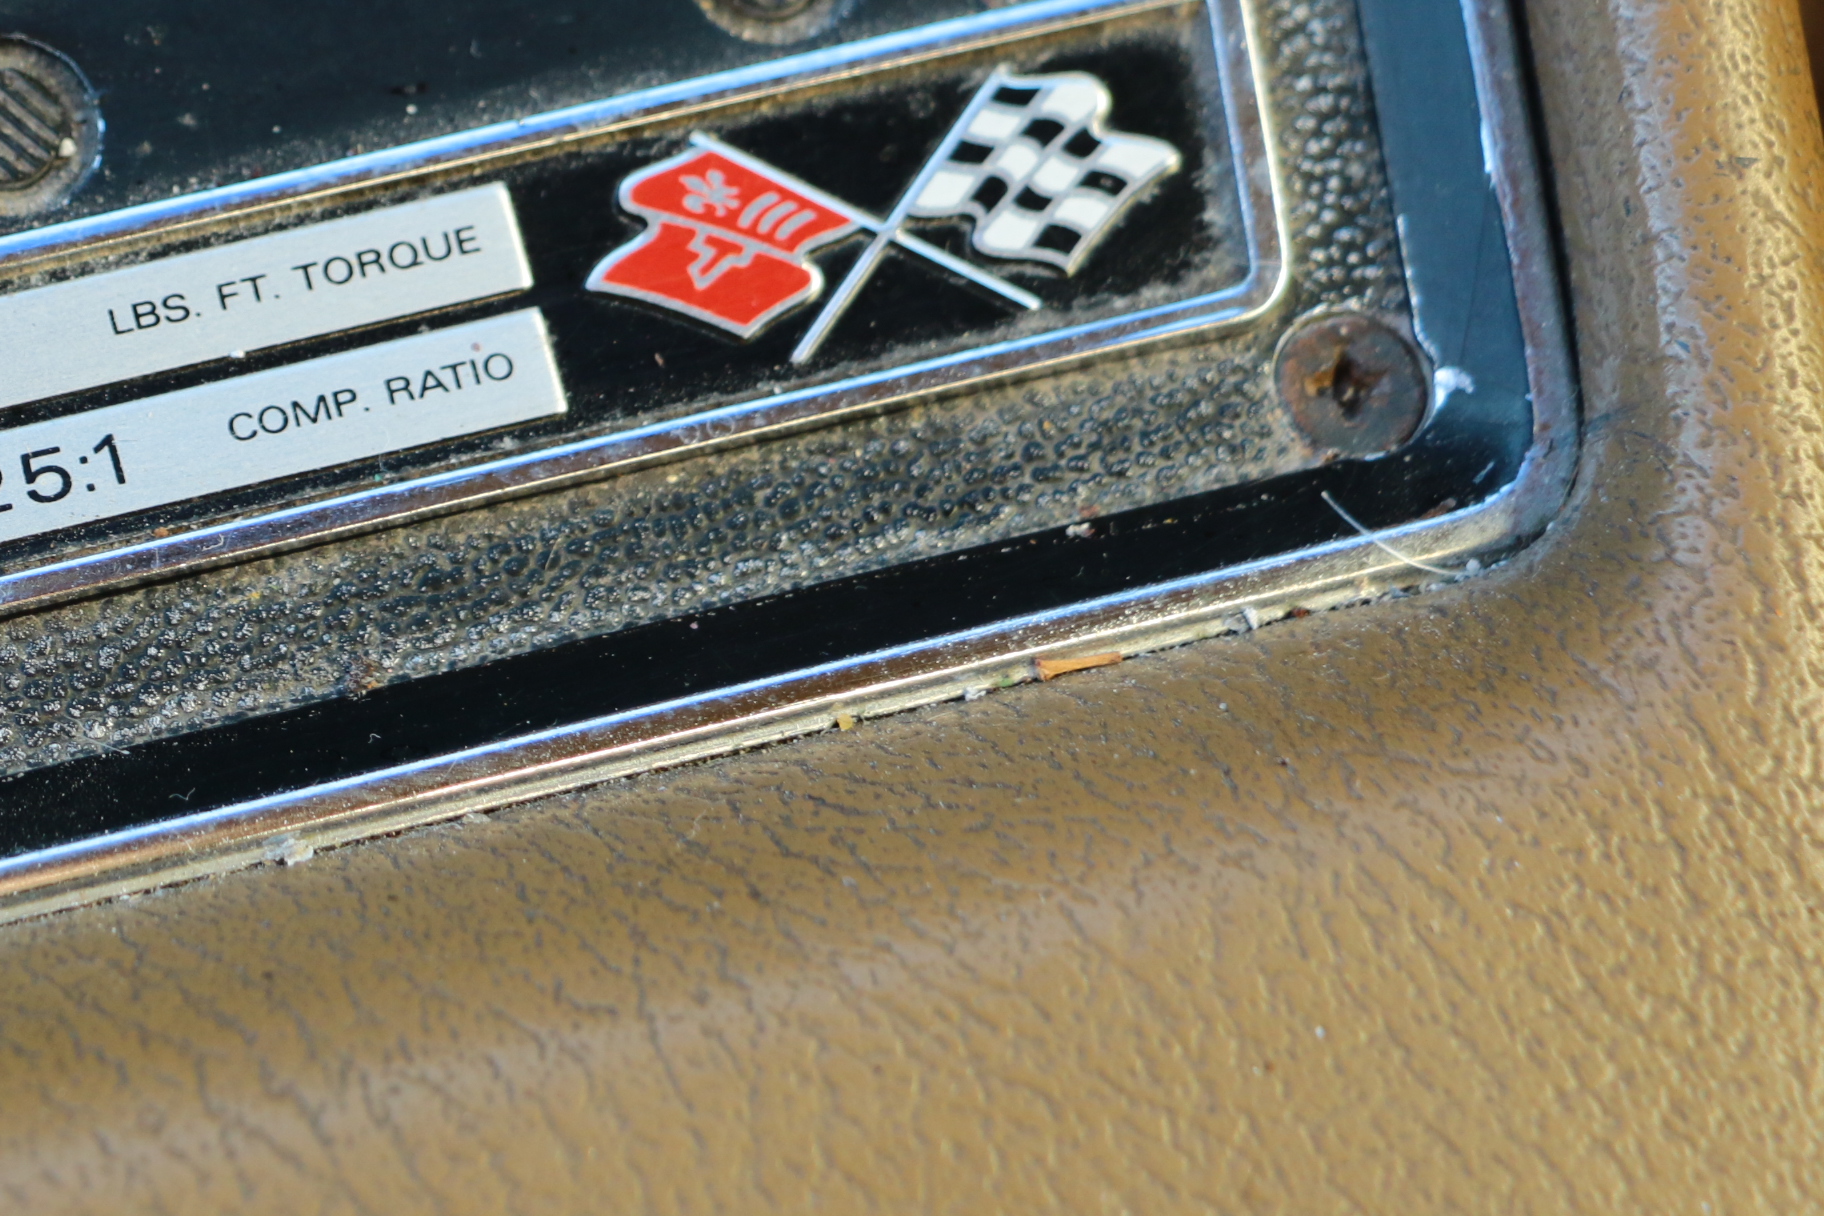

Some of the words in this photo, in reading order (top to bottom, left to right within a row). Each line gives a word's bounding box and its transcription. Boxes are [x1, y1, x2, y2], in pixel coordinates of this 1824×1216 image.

[107, 293, 201, 336] LBS.
[217, 275, 280, 311] FT.
[292, 225, 482, 292] TORQUE
[227, 388, 372, 442] COMP.
[385, 352, 515, 405] RATIO
